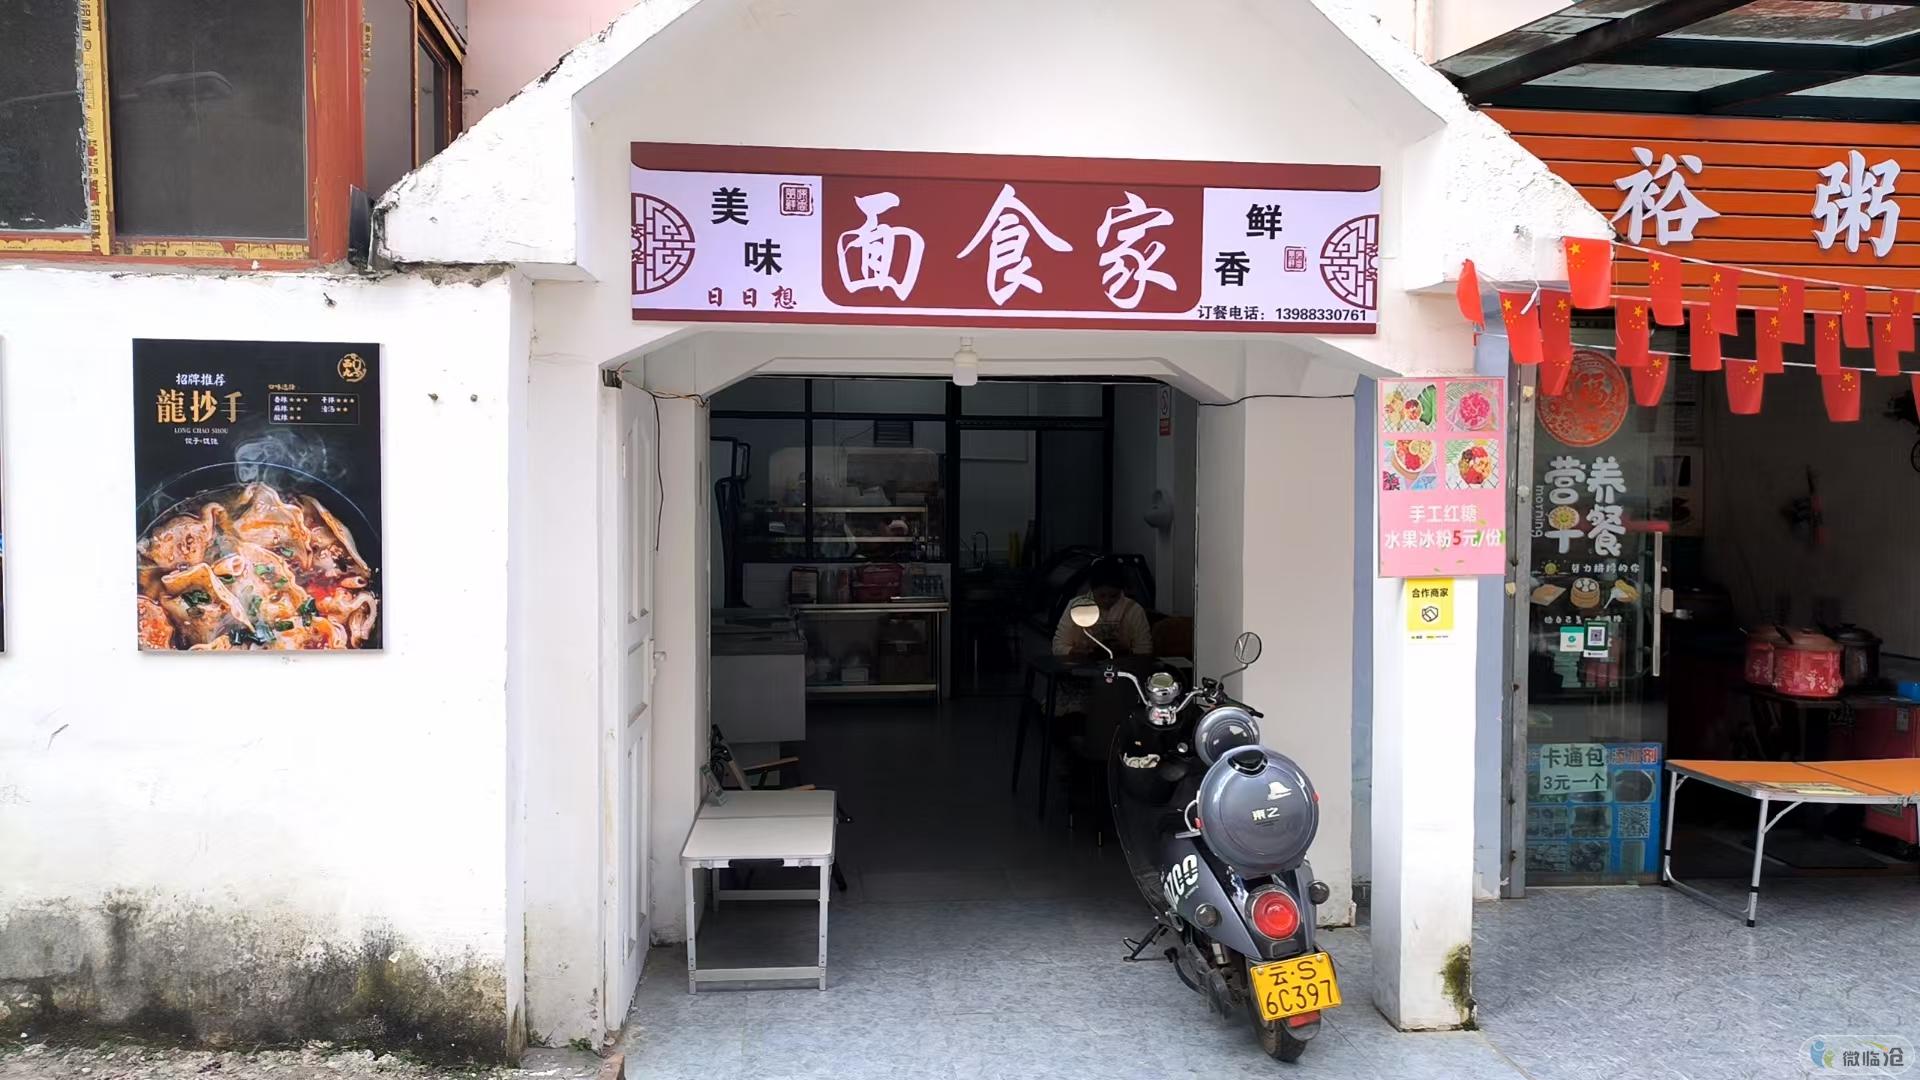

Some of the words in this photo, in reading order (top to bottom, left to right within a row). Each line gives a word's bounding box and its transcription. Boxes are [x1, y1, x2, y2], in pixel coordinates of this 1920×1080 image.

[837, 183, 1178, 310] 面食家
[707, 286, 797, 310] 日日想
[176, 373, 226, 386] 招牌推荐
[155, 389, 242, 423] 龍抄手
[1408, 504, 1478, 524] 手工红糖
[1530, 485, 1544, 538] morning
[1411, 587, 1449, 598] 合作商家
[1542, 746, 1605, 769] 卡通包
[1543, 773, 1605, 791] 3元一个
[1265, 979, 1334, 1016] 6C397
